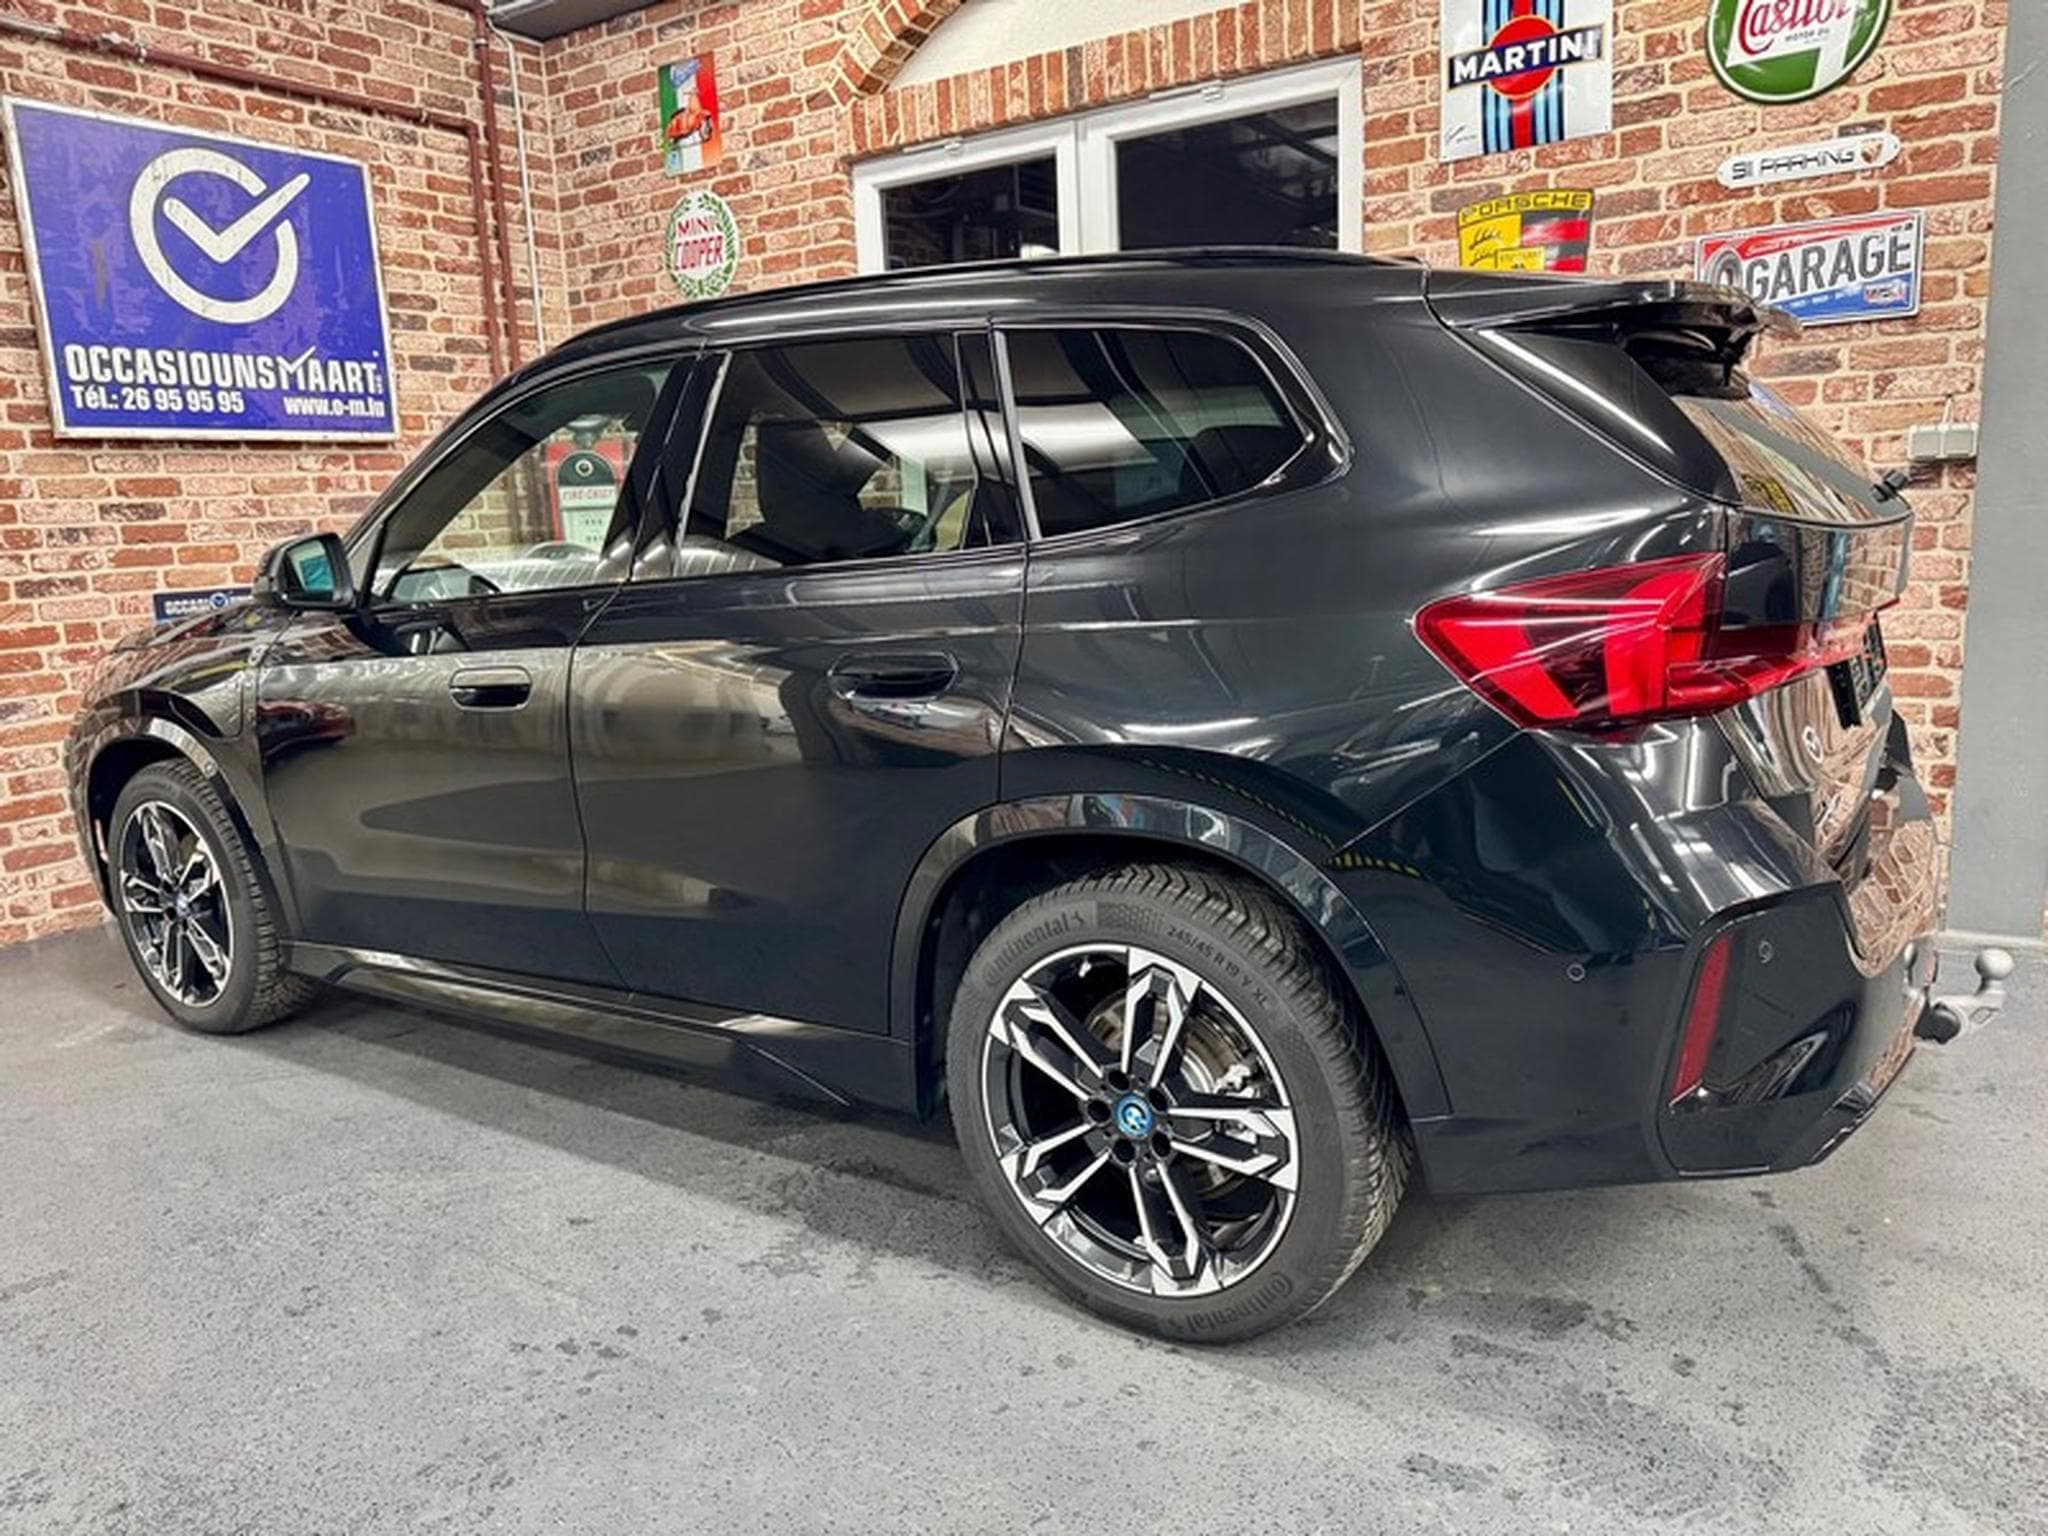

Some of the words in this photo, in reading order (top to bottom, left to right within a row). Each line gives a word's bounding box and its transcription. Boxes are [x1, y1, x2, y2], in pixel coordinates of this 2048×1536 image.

[1453, 30, 1596, 83] MARTINI
[1760, 150, 1855, 175] PARKING
[1461, 192, 1588, 222] PORSCHE
[676, 214, 715, 238] MINI
[674, 235, 723, 271] COOPER
[1746, 223, 1913, 303] GARAGE
[64, 344, 377, 395] OCCASIOUNSMAART
[121, 386, 151, 411] 26
[154, 388, 183, 412] 95
[186, 389, 214, 413] 95
[216, 391, 245, 413] 95
[983, 911, 1070, 986] Continental
